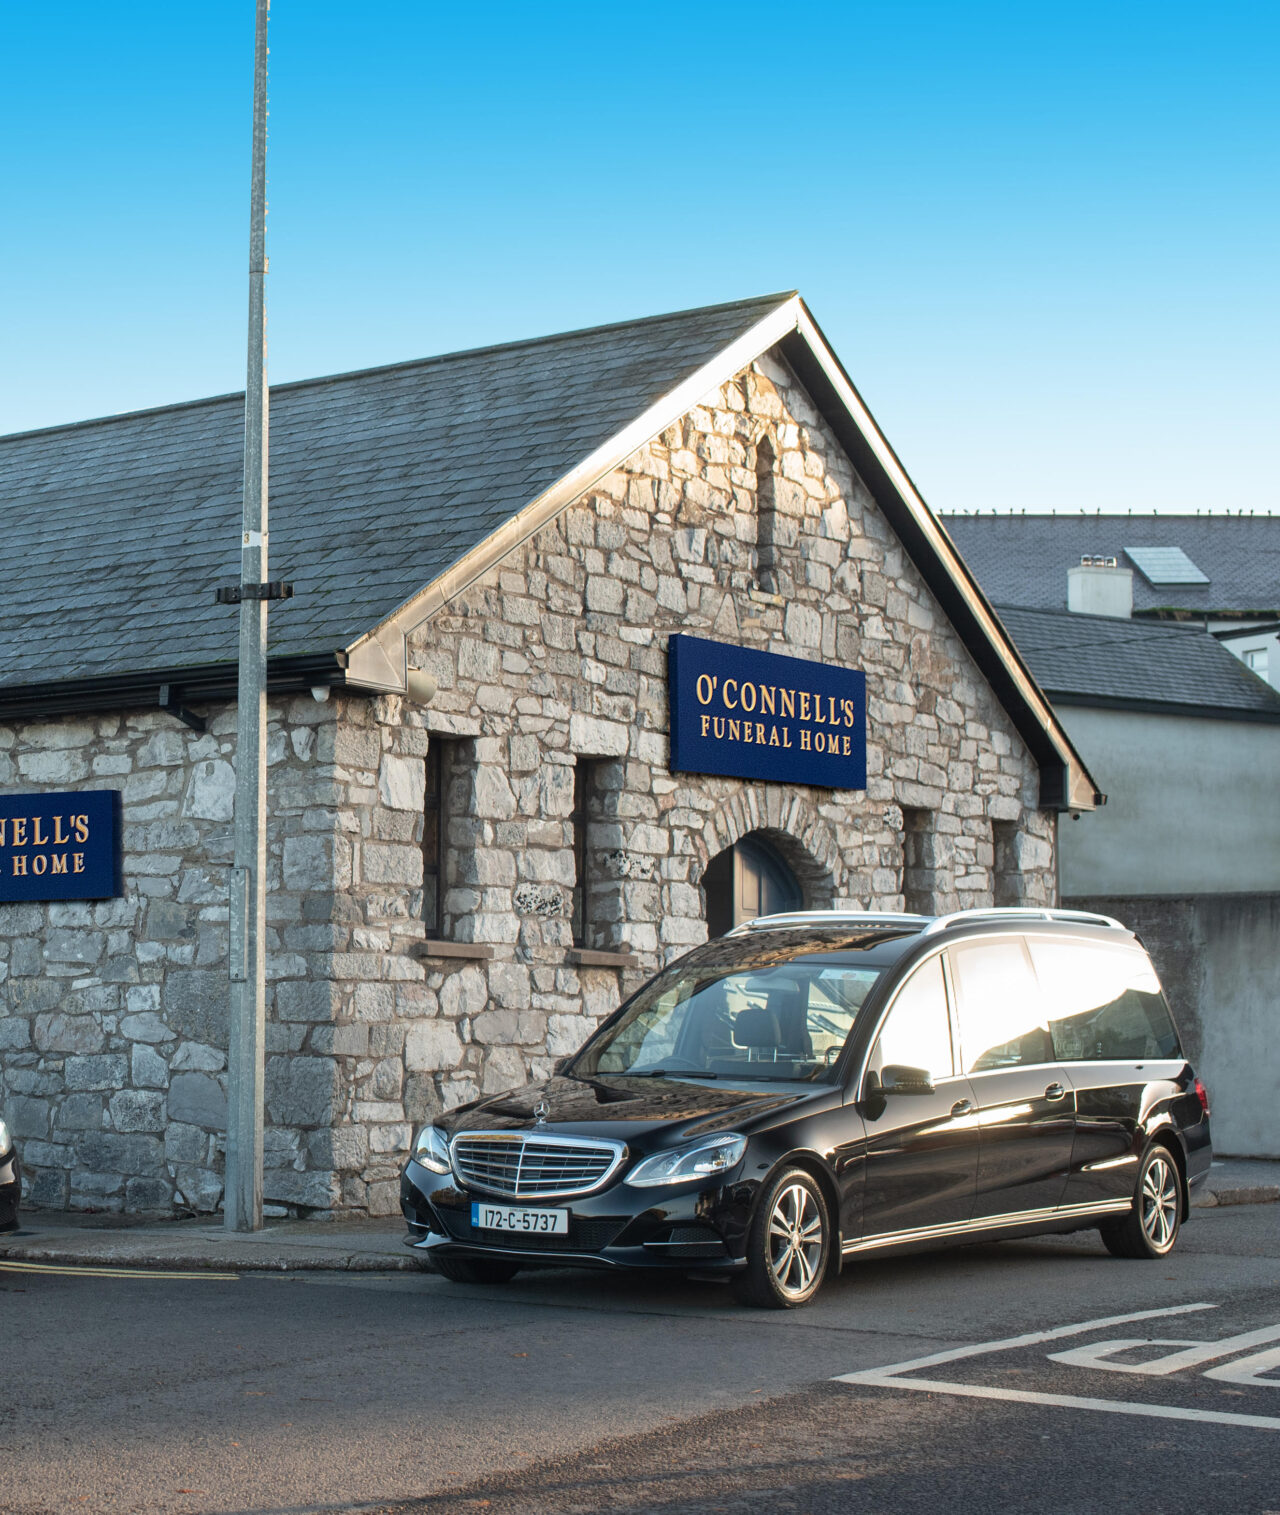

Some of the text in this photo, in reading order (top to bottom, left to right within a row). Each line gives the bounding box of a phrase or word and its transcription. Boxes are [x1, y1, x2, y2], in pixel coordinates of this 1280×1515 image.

[696, 673, 855, 728] O'CONNELL'S
[700, 714, 852, 756] FUNERAL HOME
[11, 852, 86, 876] HOME
[485, 1209, 558, 1232] 172-C-5737
